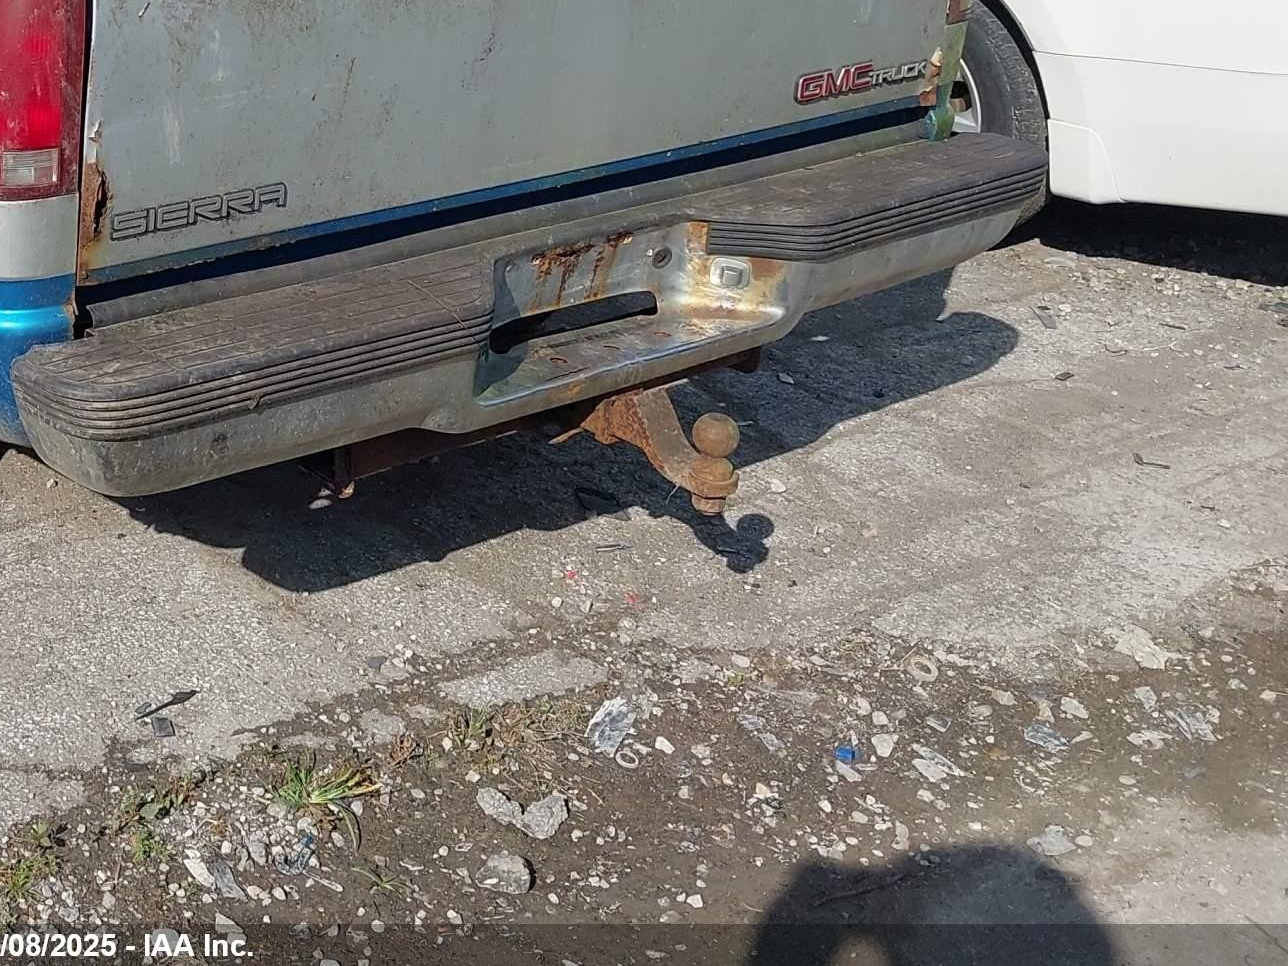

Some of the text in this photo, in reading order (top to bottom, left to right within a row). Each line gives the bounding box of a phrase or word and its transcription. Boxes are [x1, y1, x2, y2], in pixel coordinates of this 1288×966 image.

[794, 60, 928, 104] GMC TRUCK
[111, 182, 289, 241] SIERRA
